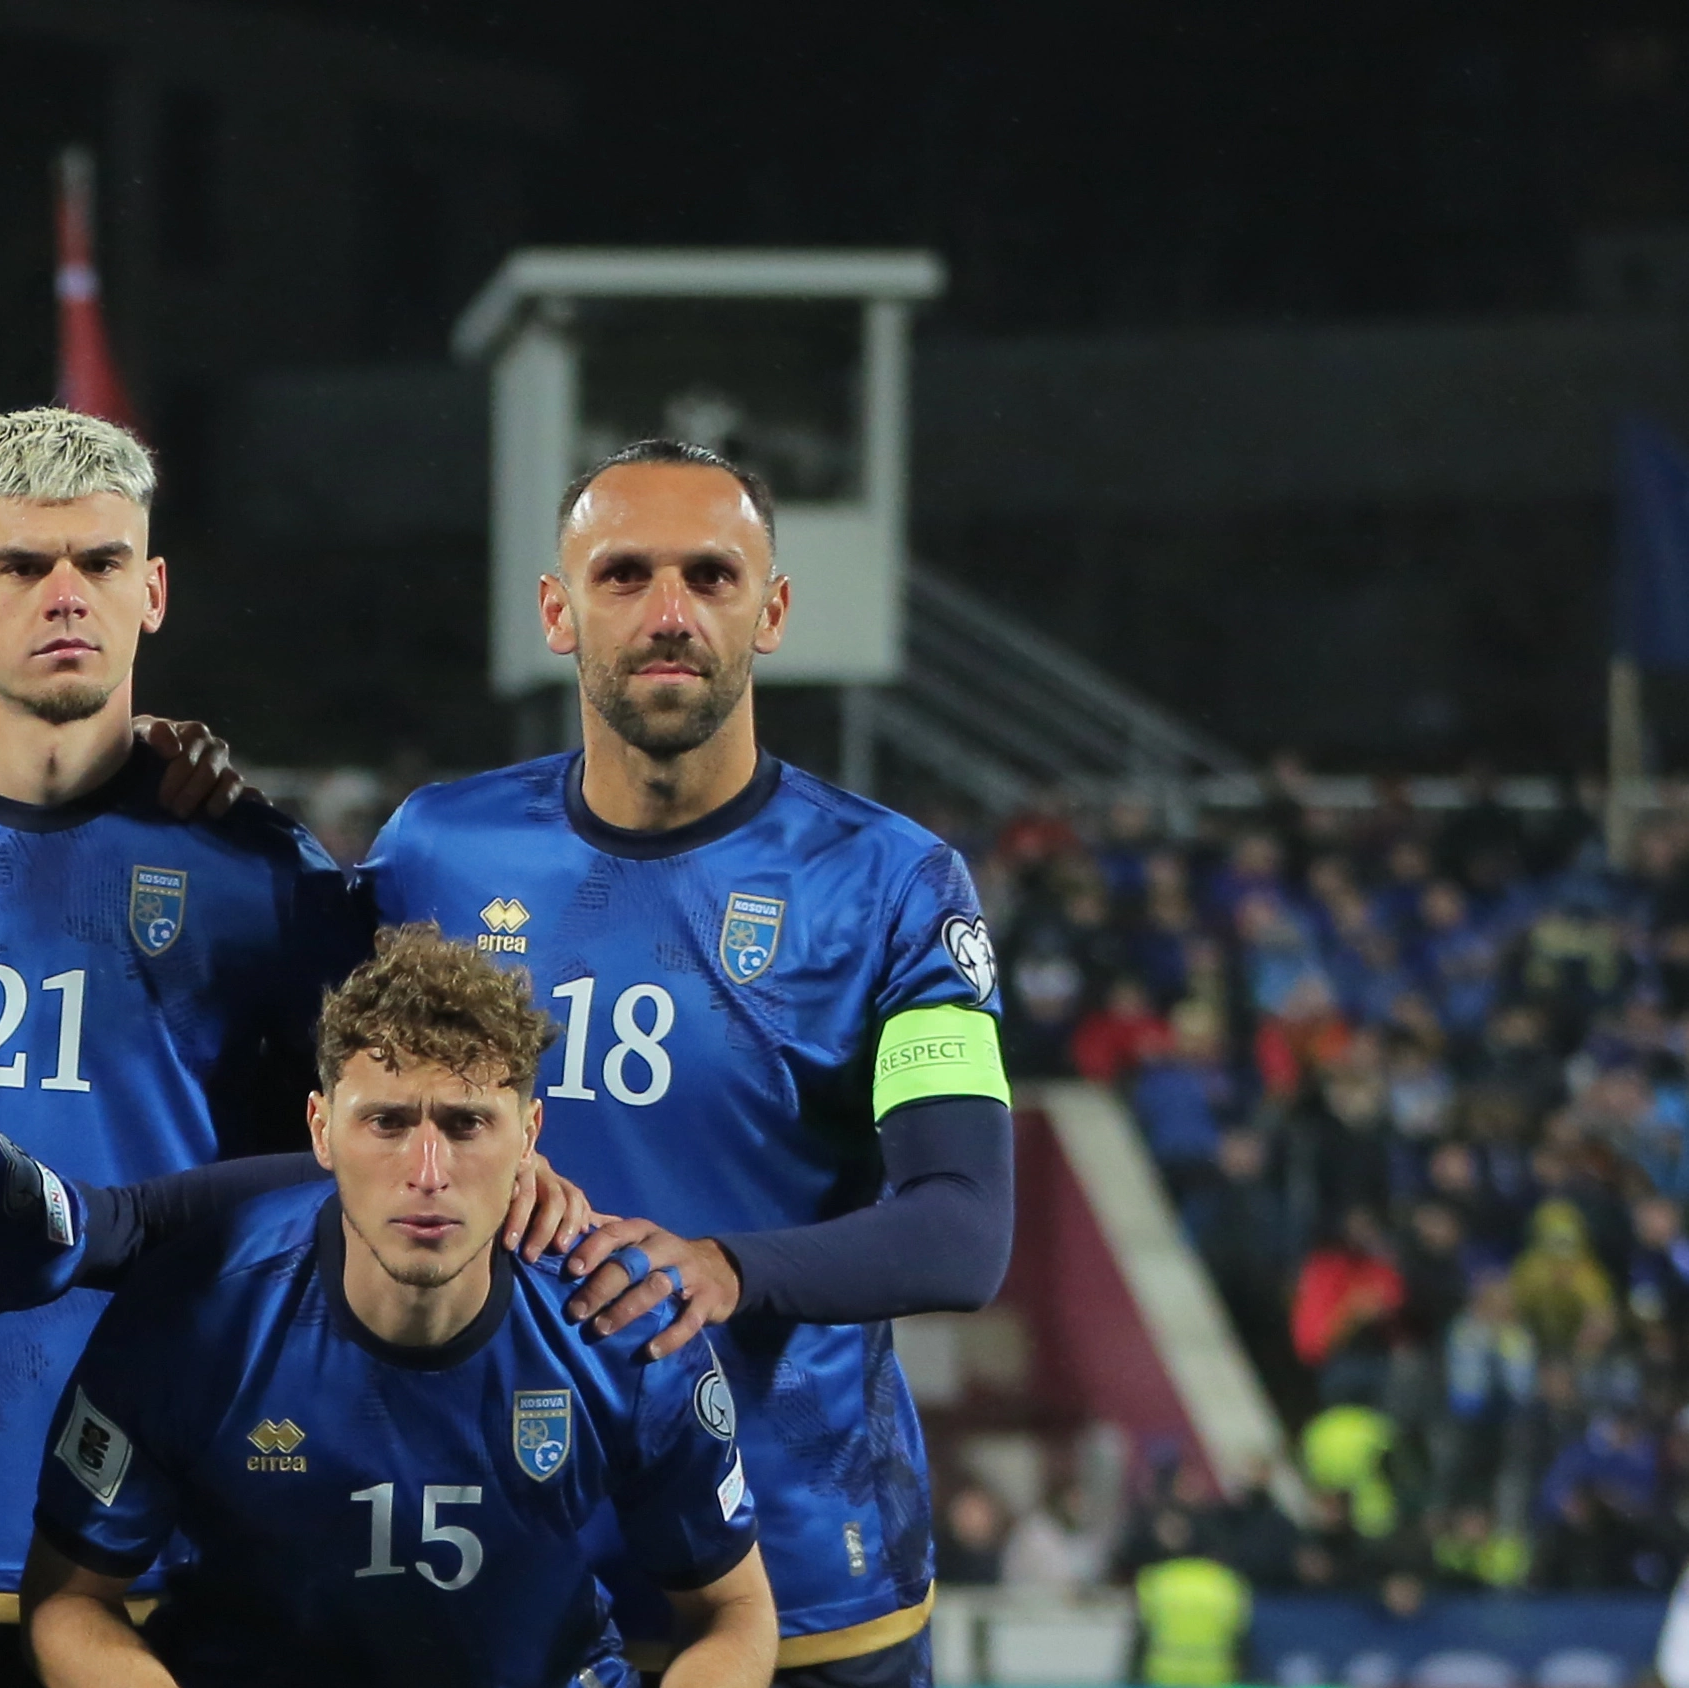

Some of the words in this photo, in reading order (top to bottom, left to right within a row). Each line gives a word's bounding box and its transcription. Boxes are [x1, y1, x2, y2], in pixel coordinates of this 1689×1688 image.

[138, 873, 180, 888] KOSOVA
[734, 900, 777, 917] KOSOVA
[546, 976, 674, 1106] 18
[879, 1041, 966, 1075] RESPECT
[520, 1397, 566, 1408] KOSOVA
[350, 1483, 483, 1591] 15
